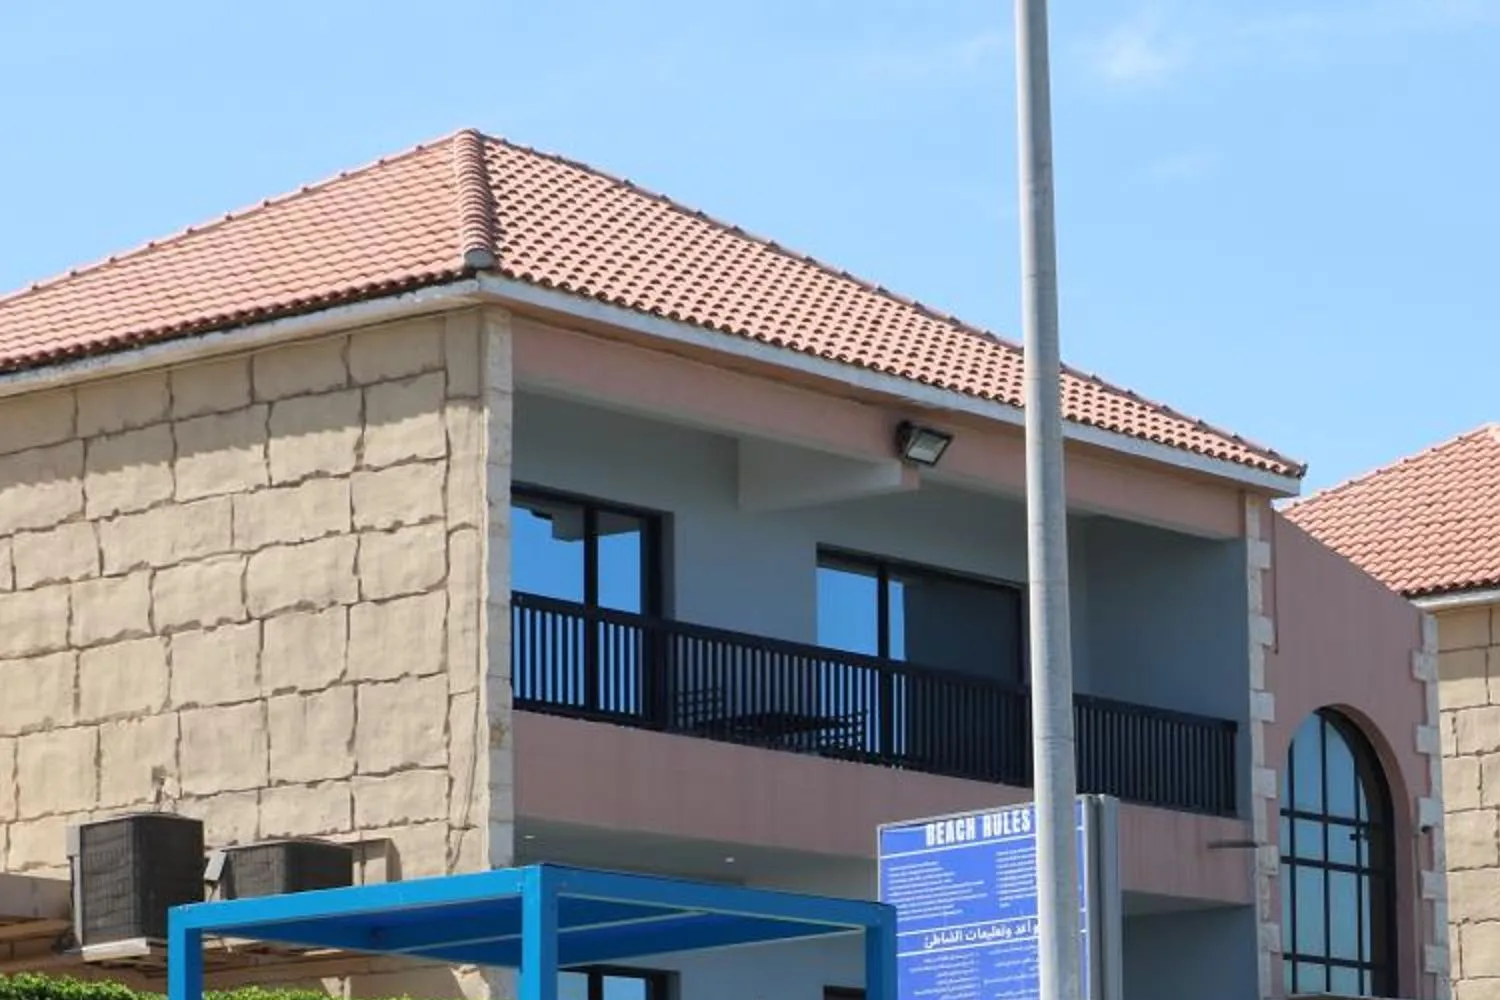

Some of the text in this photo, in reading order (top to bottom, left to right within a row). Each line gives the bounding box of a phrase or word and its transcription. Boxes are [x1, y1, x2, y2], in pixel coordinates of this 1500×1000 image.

[927, 810, 1030, 846] BEACH RULES
[923, 929, 962, 949] الشاطئ
[965, 925, 1012, 941] وتعليمات
